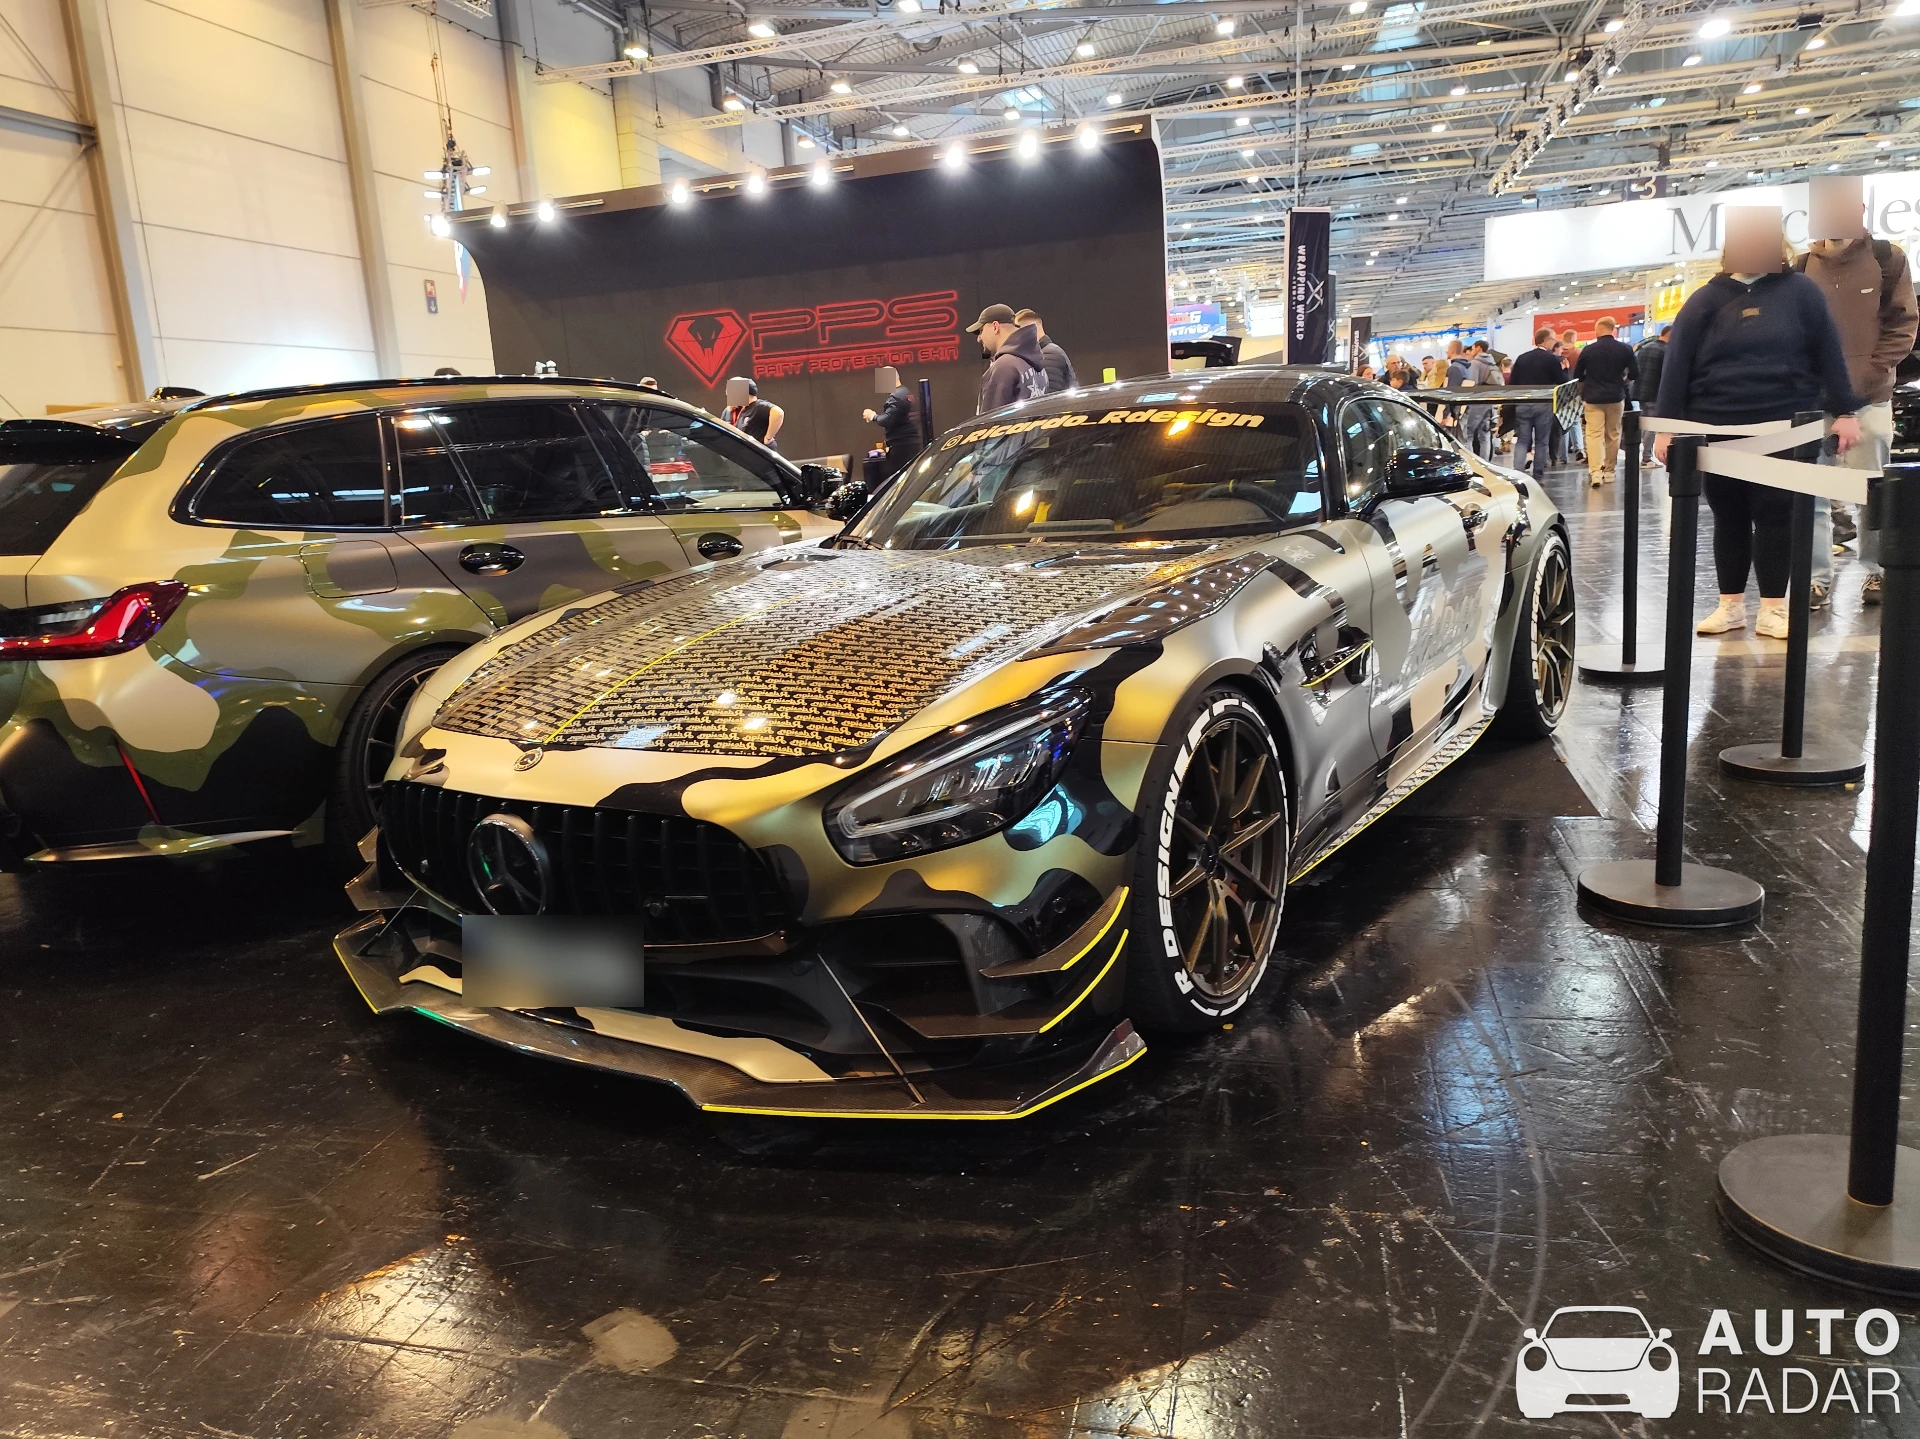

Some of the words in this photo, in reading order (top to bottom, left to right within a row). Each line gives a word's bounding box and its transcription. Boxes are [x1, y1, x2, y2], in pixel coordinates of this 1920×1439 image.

[1296, 245, 1306, 302] WRAPPING
[749, 290, 958, 350] PPS
[1296, 304, 1305, 340] WORLD
[755, 362, 802, 379] PAINT
[809, 351, 914, 373] PROTECTION
[918, 347, 959, 363] SKIN
[963, 408, 1265, 445] Ricardo_Rdesign
[1157, 773, 1181, 958] DESIGN
